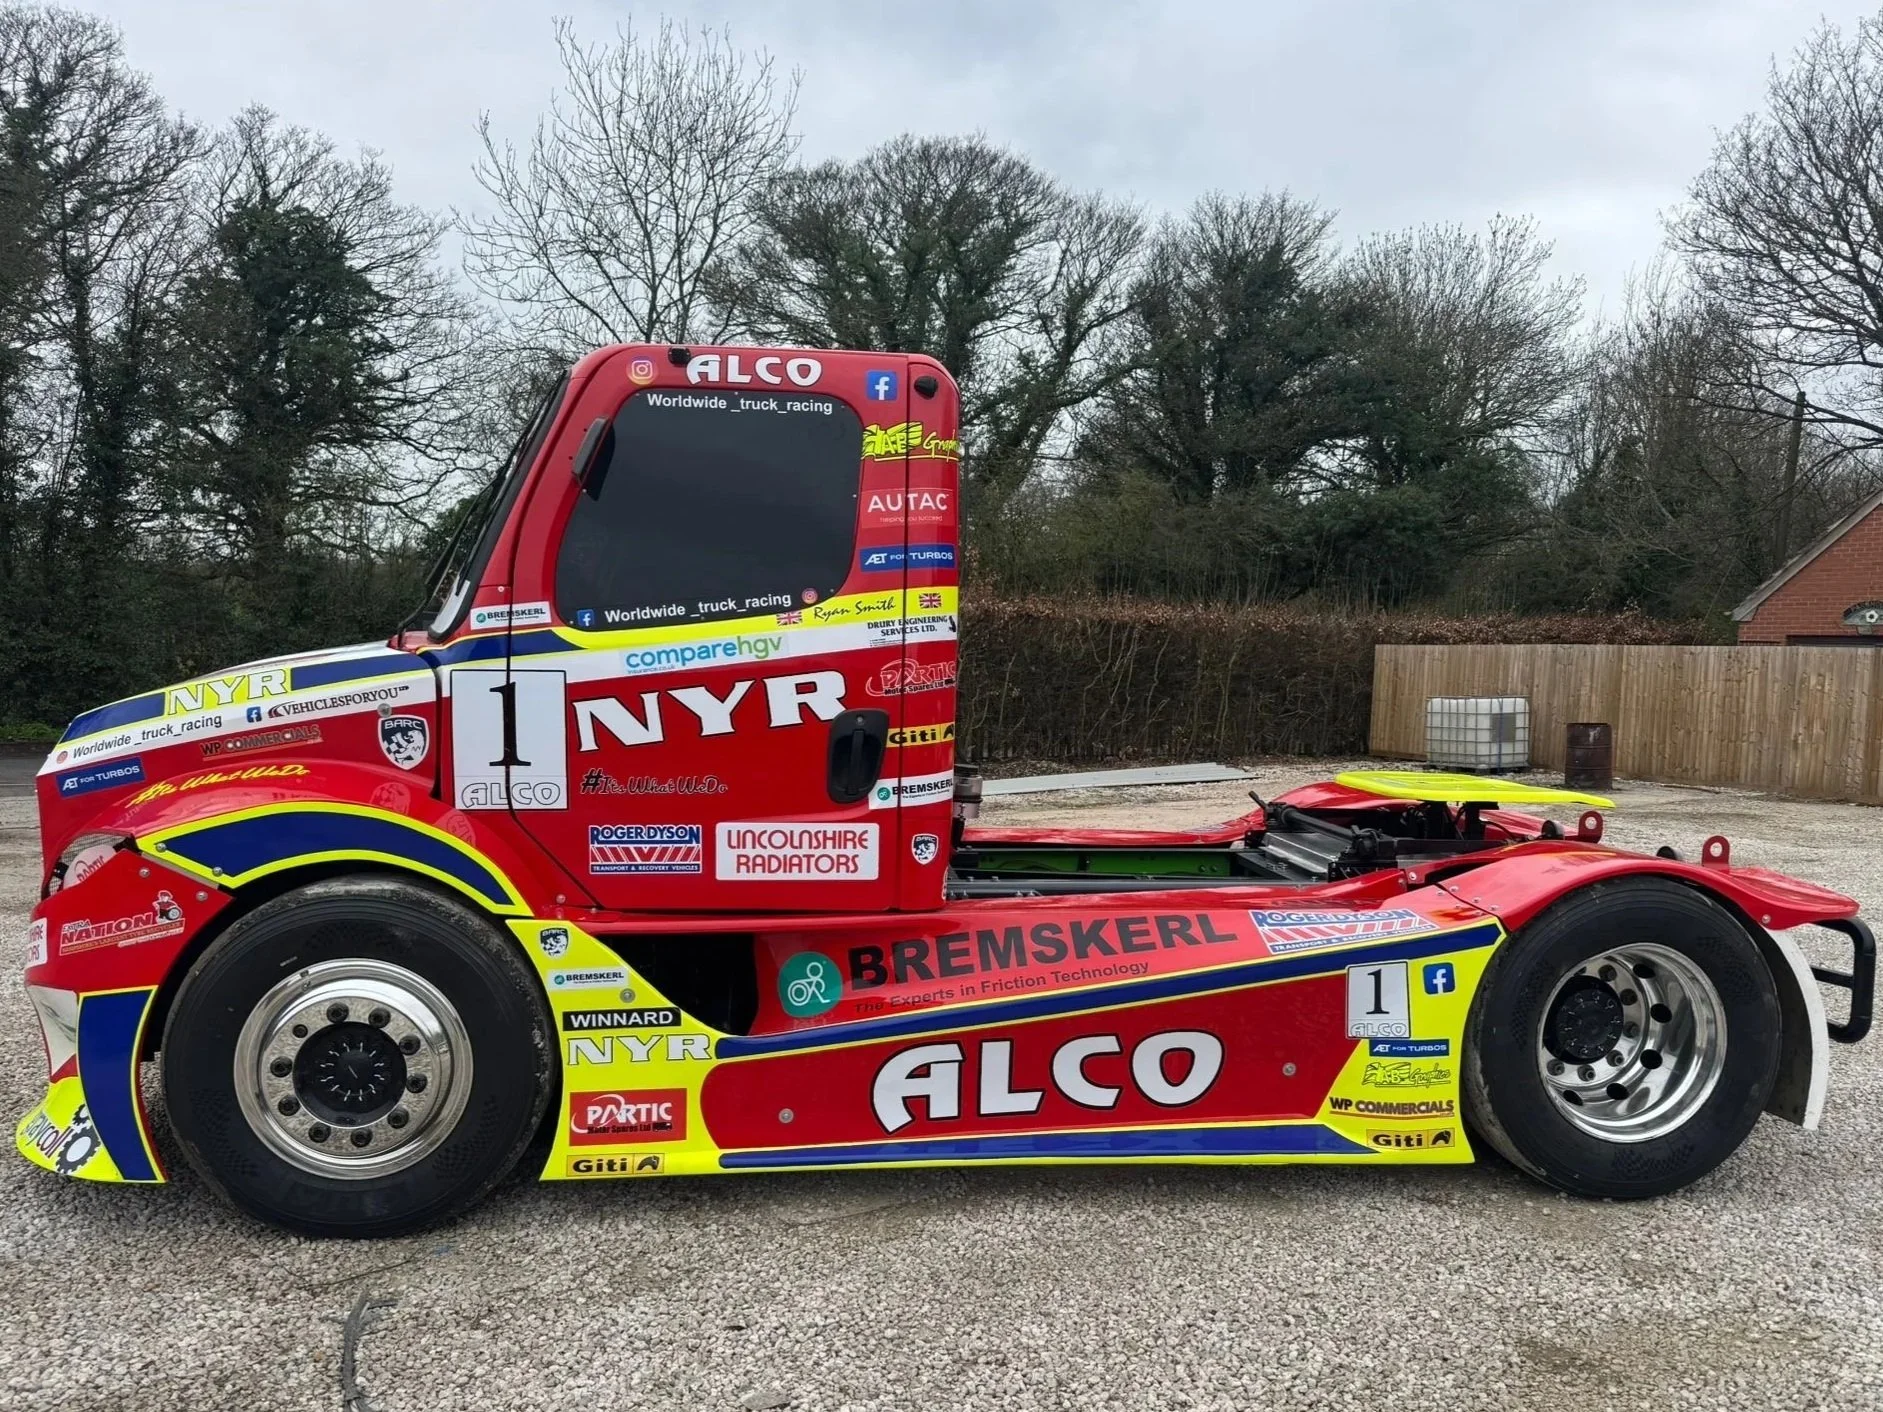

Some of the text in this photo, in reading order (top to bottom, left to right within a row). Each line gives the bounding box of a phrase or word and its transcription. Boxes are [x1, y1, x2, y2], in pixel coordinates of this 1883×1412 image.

[686, 354, 822, 386] ALCO
[647, 393, 727, 409] Worldwide
[867, 492, 948, 513] AUTAC
[909, 551, 954, 561] TURBOS
[486, 607, 546, 619] BREMSKERL
[604, 604, 686, 624] Worldwide
[813, 596, 896, 622] Ryan Smith
[867, 615, 948, 630] DRURY ENGINEERING
[880, 625, 920, 637] SERVICES
[625, 635, 782, 666] comparehgv
[168, 668, 288, 715] NYR
[908, 684, 934, 693] Spares
[282, 687, 399, 716] VEHICLESFORYOU
[572, 669, 848, 752] NYR
[384, 719, 422, 730] BARC
[489, 681, 532, 766] 1
[72, 734, 131, 759] Worldwide
[200, 725, 322, 756] WP COMMERCIALS
[889, 728, 937, 744] Giti
[80, 776, 95, 784] FOR
[96, 765, 140, 781] TURBOS
[461, 781, 560, 808] ALCO
[726, 829, 869, 850] LINCOLNSHIRE
[736, 853, 860, 874] RADIATORS
[61, 913, 153, 945] NATION
[847, 913, 1238, 992] BREMSKERL
[1274, 939, 1328, 951] TRANSPORT
[565, 971, 625, 981] BREMSKERL
[854, 959, 1150, 1014] The Experts in Friction Technology
[1365, 968, 1390, 1015] 1
[569, 1010, 673, 1028] WINNARD
[1350, 1022, 1407, 1037] ALCO
[567, 1033, 712, 1066] NYR
[1408, 1043, 1447, 1052] TURBOS
[870, 1029, 1226, 1136] ALCO
[587, 1102, 673, 1126] PARTIC
[1329, 1096, 1454, 1115] WP COMMERCIALS
[639, 1123, 651, 1132] Ltd
[1372, 1133, 1423, 1148] Giti
[572, 1157, 628, 1173] Giti
